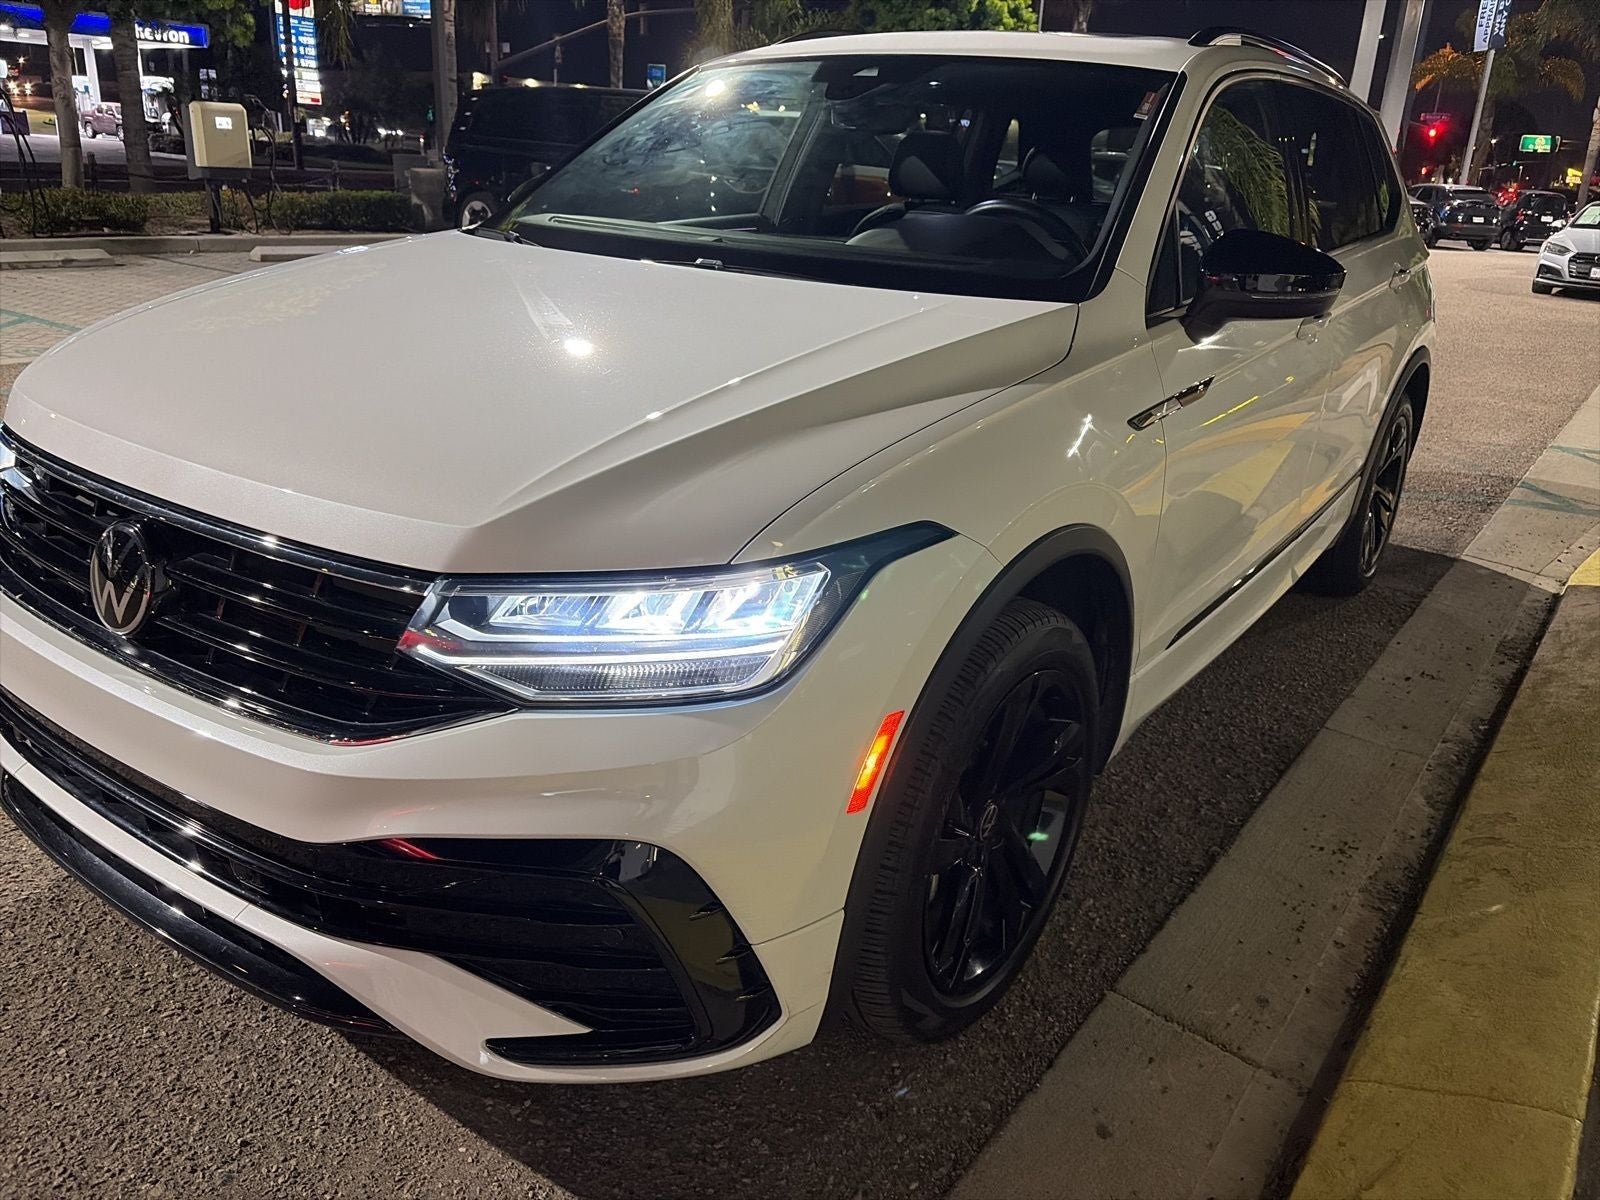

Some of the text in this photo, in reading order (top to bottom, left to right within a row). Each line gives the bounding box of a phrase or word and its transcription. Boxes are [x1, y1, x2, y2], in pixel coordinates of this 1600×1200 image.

[1478, 0, 1488, 28] FRE
[1499, 10, 1508, 37] ANY
[134, 23, 190, 43] hevron
